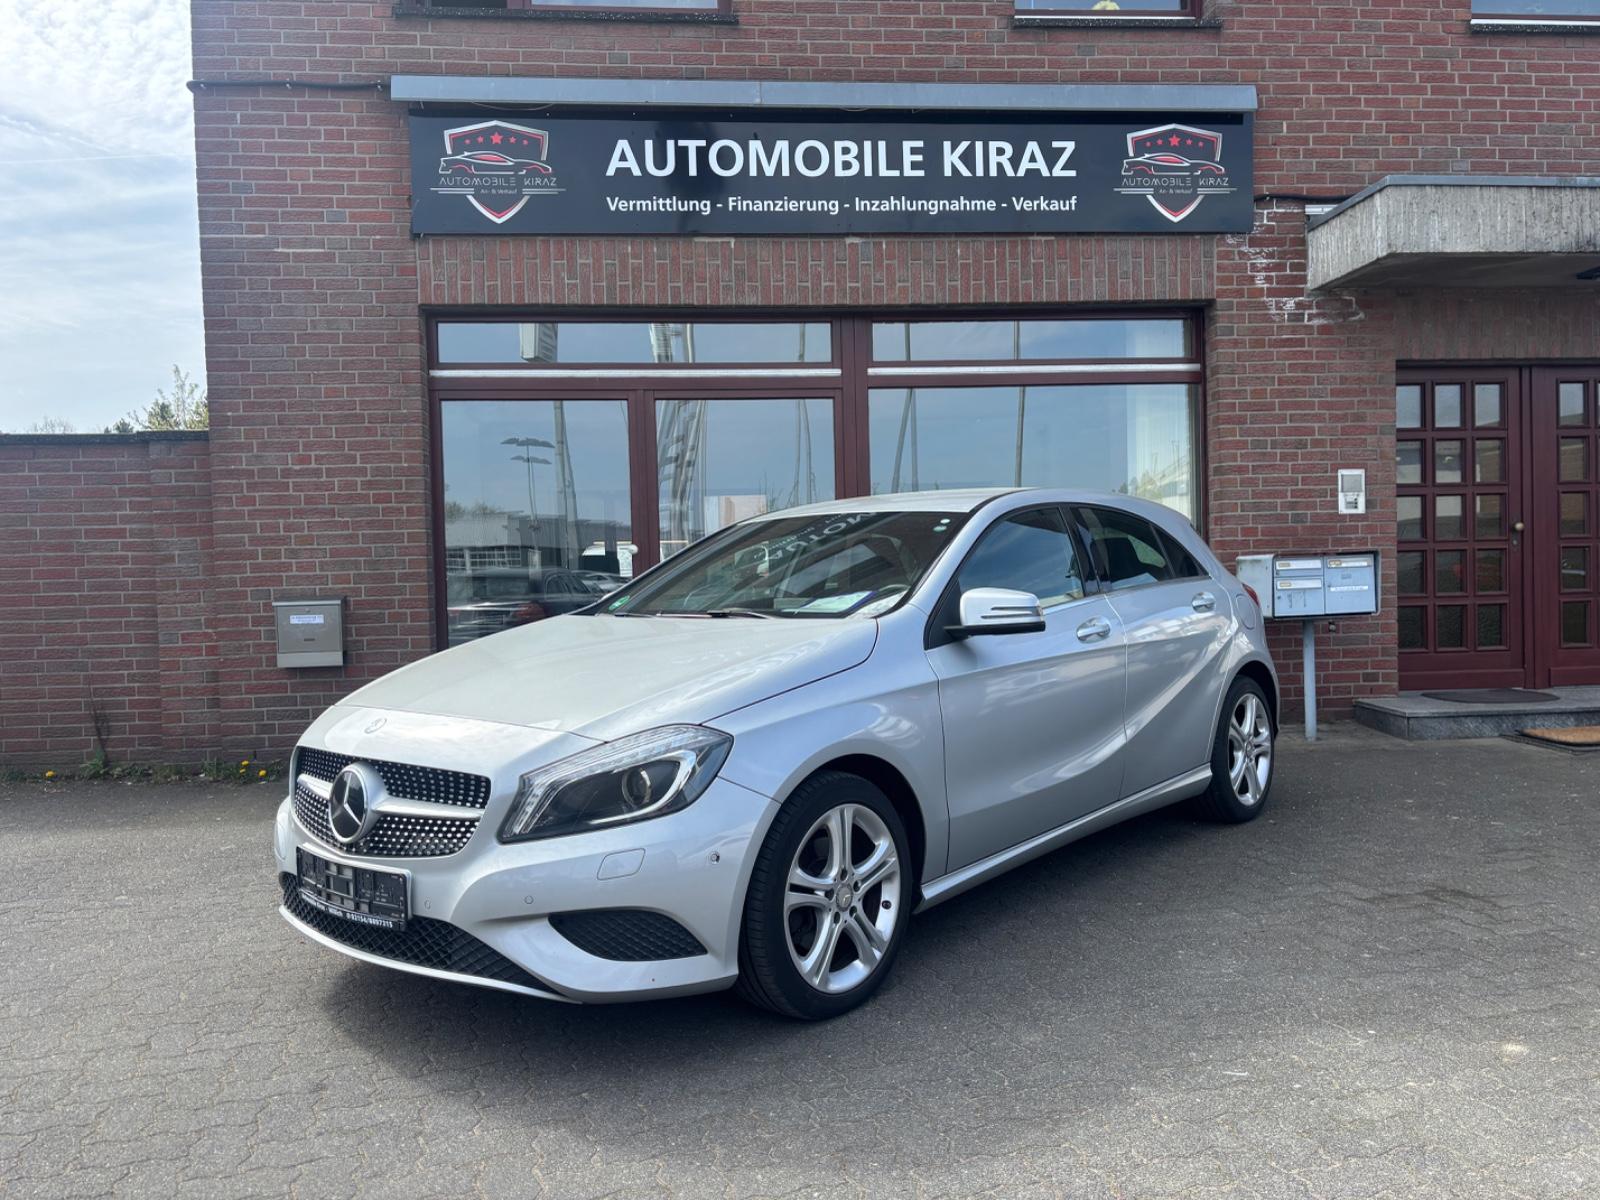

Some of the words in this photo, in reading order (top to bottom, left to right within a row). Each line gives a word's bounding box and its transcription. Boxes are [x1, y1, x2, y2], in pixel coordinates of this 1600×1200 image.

[605, 139, 925, 178] AUTOMOBILE
[942, 140, 1078, 178] KIRAZ
[439, 177, 517, 186] AUTOMOBILE
[523, 177, 557, 186] KIRAZ
[1121, 177, 1192, 186] AUTOMOBILE
[1199, 177, 1229, 186] KIRAZ
[606, 195, 711, 216] Vermittlung
[728, 195, 839, 216] Finanzierung
[855, 195, 997, 215] Inzahlungnahme
[1012, 195, 1078, 212] Verkauf
